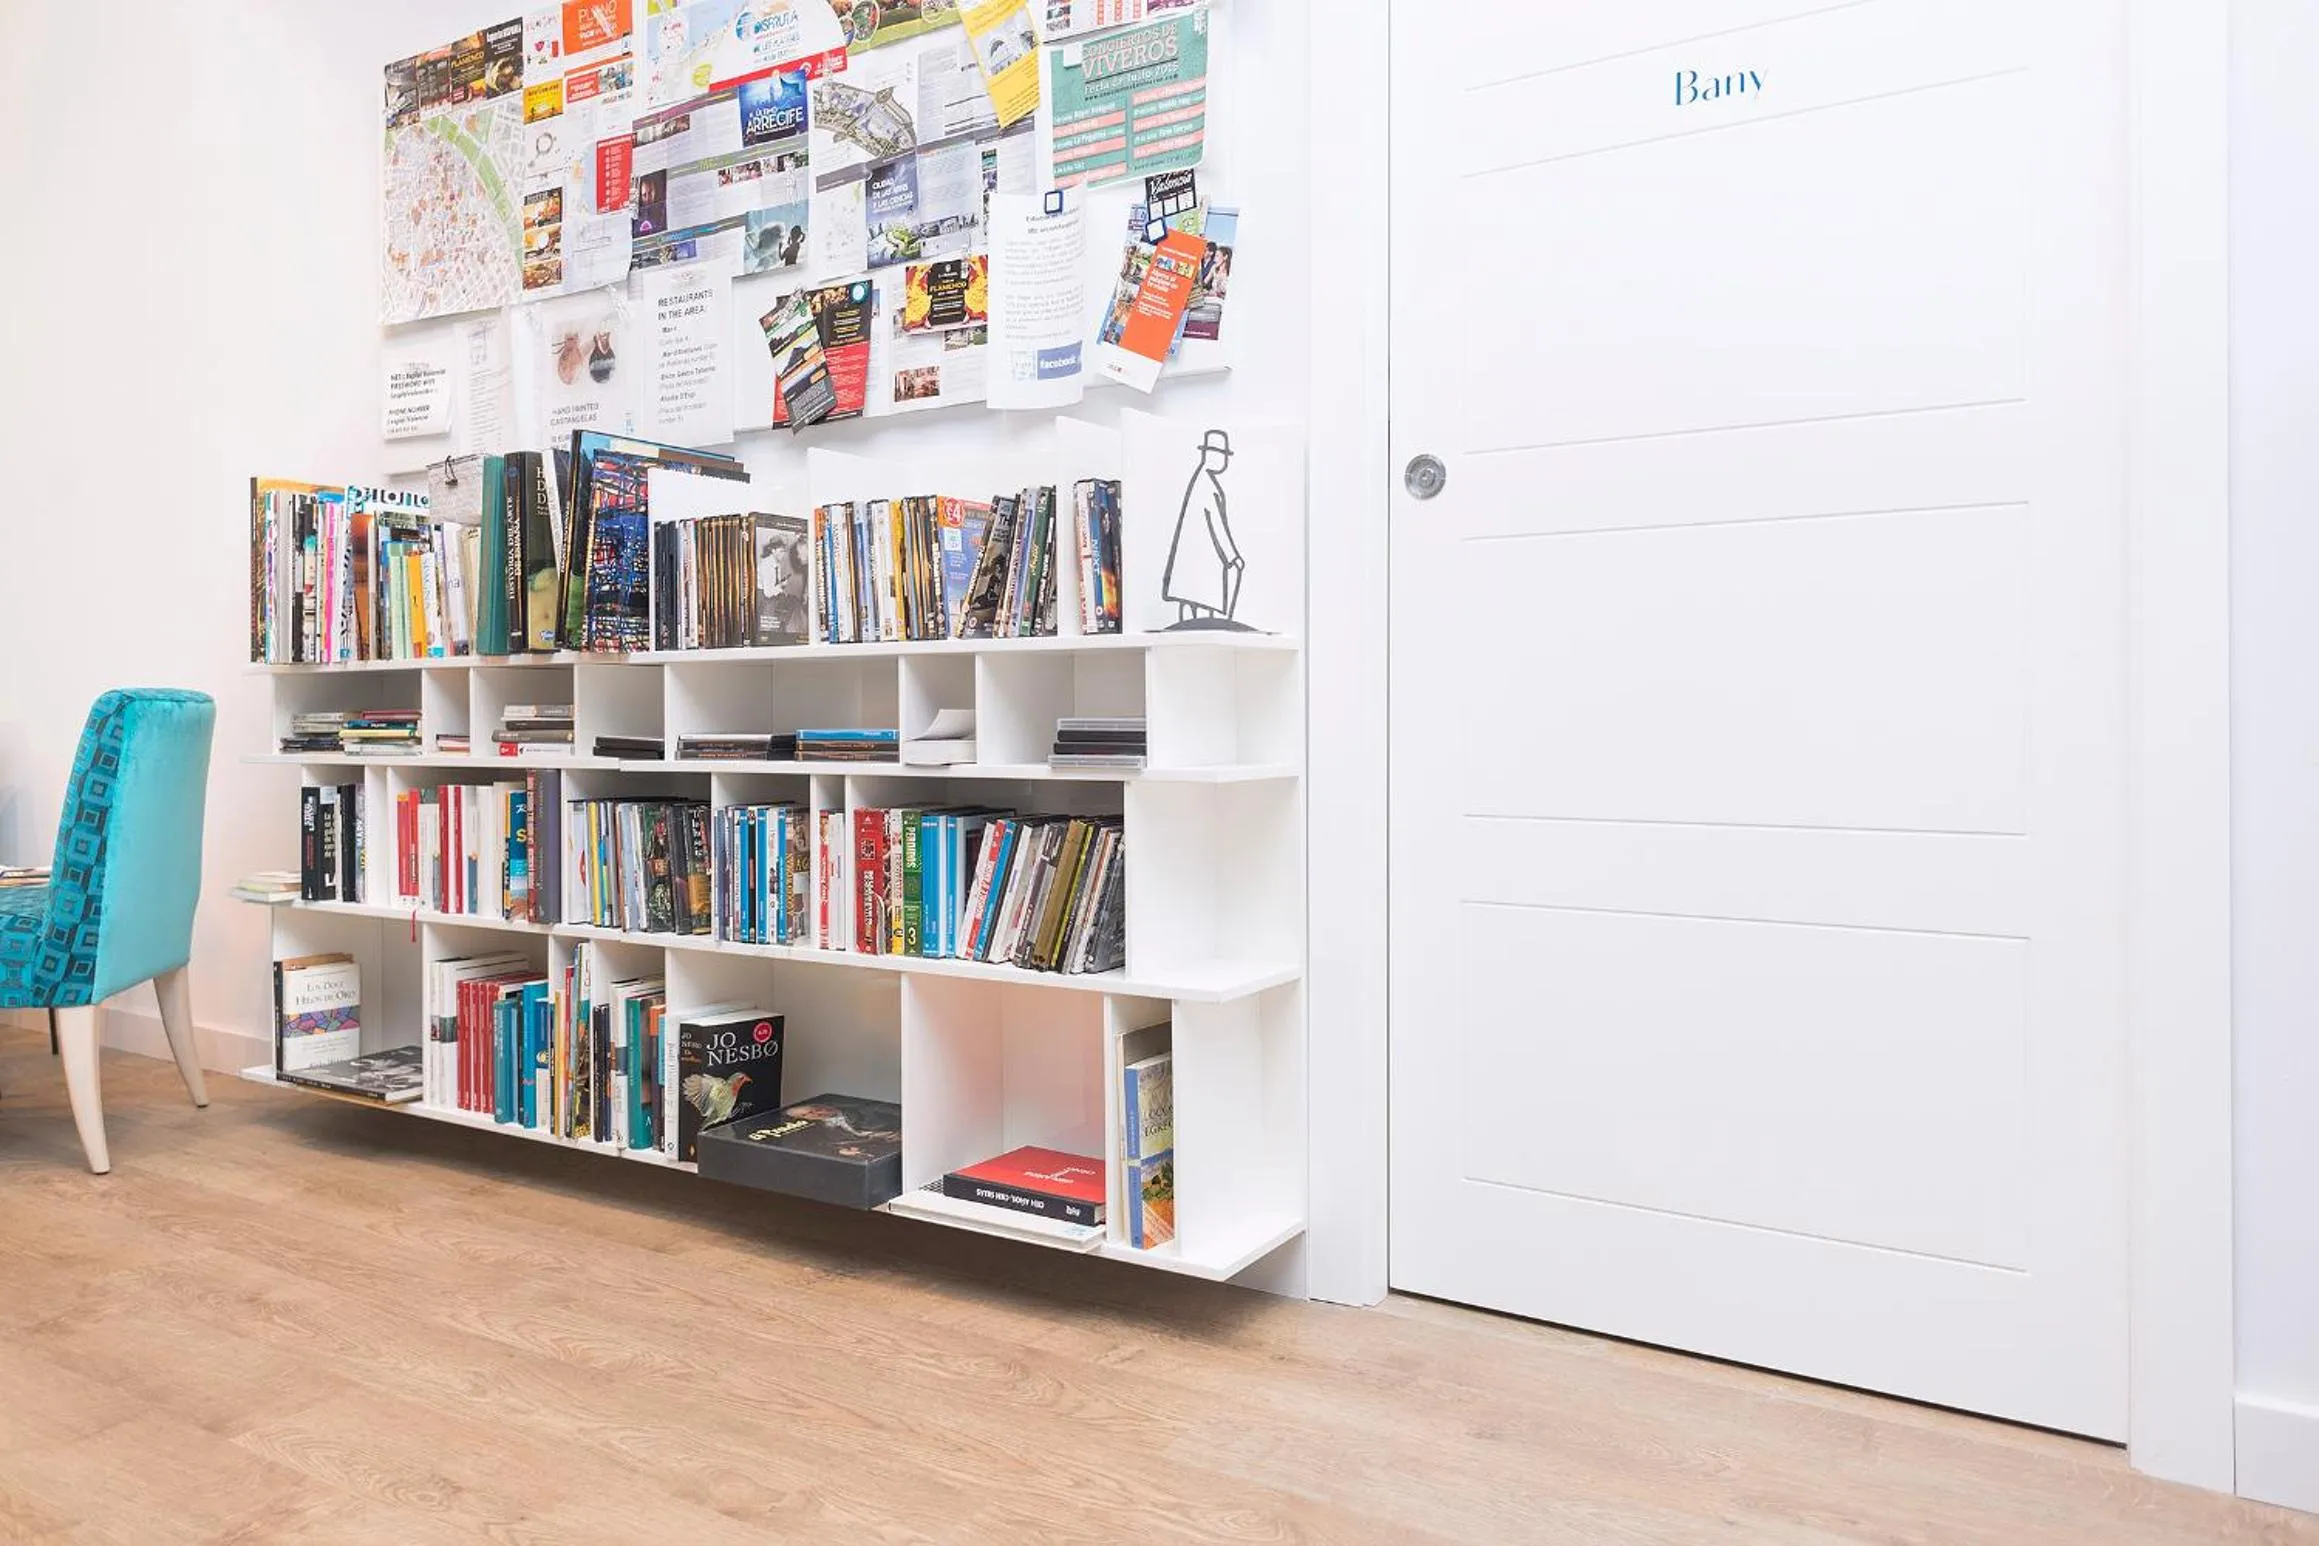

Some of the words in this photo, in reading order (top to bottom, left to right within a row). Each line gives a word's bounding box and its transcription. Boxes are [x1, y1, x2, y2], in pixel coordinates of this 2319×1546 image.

[1082, 35, 1178, 79] VIVEROS
[1676, 68, 1769, 106] Bany
[747, 106, 804, 135] ARRECIFE
[658, 289, 714, 307] RESTAURANTS
[669, 308, 682, 319] THE
[908, 926, 917, 946] 3
[706, 1031, 737, 1051] JO
[706, 1040, 779, 1067] NESBØ
